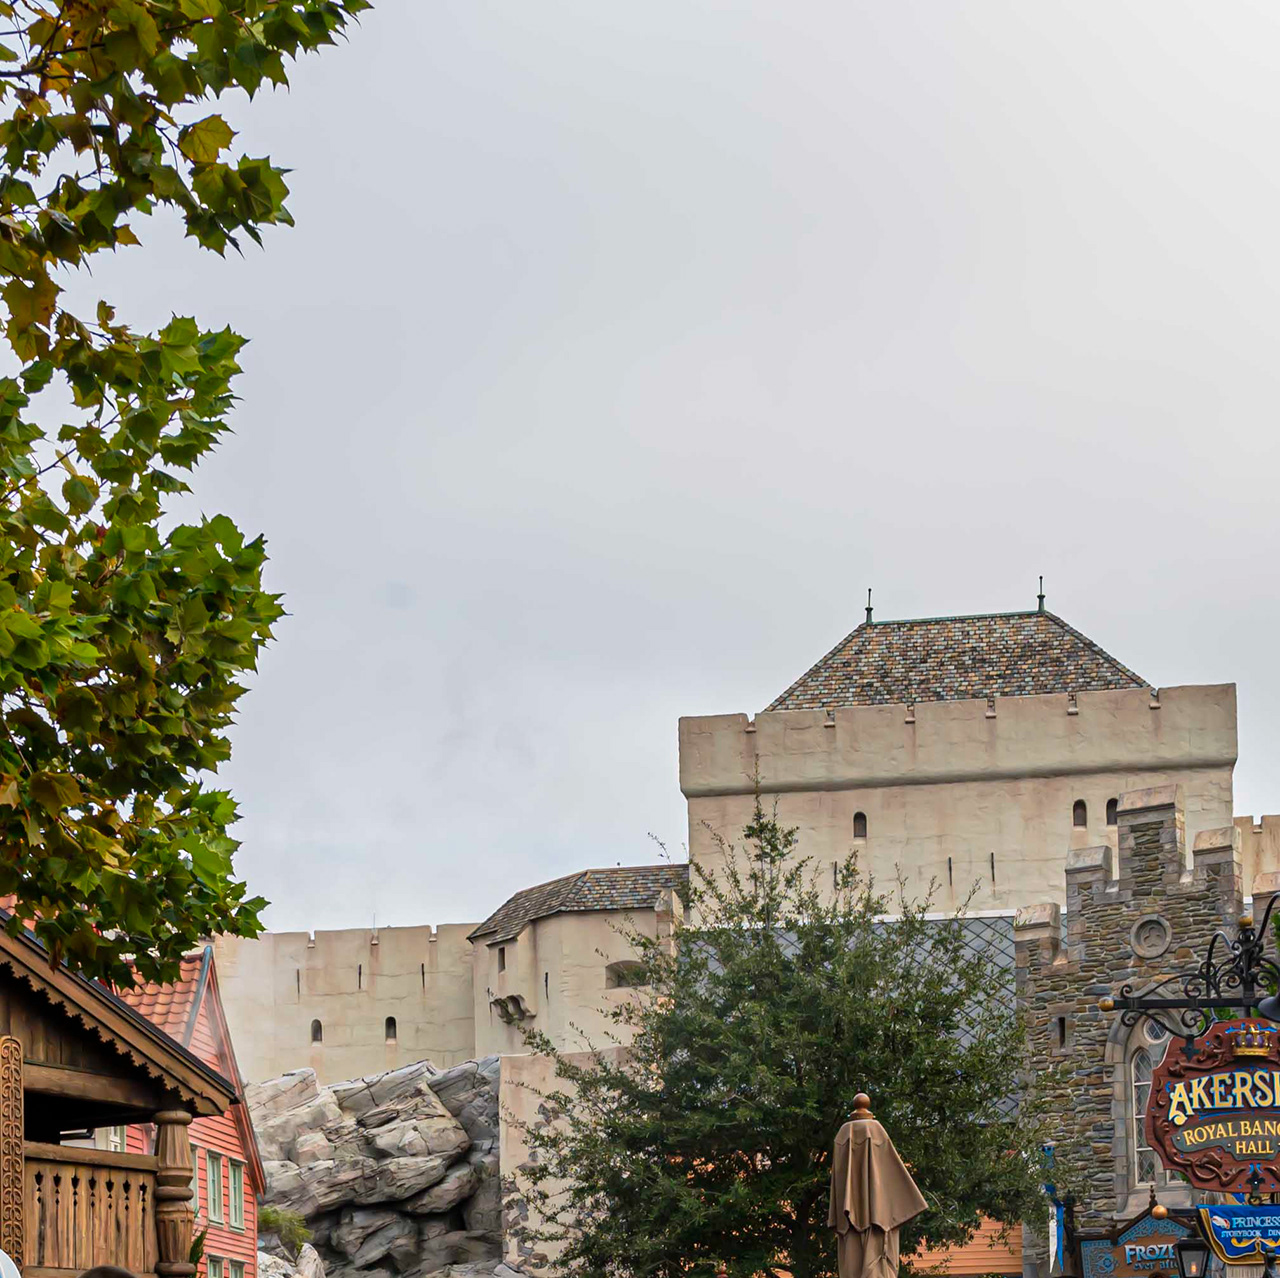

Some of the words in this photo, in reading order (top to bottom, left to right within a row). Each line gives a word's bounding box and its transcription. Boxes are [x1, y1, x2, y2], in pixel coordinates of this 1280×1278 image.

[1182, 1122, 1238, 1146] ROYAL
[1235, 1140, 1274, 1155] HALL
[1221, 1229, 1262, 1238] STORYBOOK
[1124, 1244, 1176, 1265] FROZE
